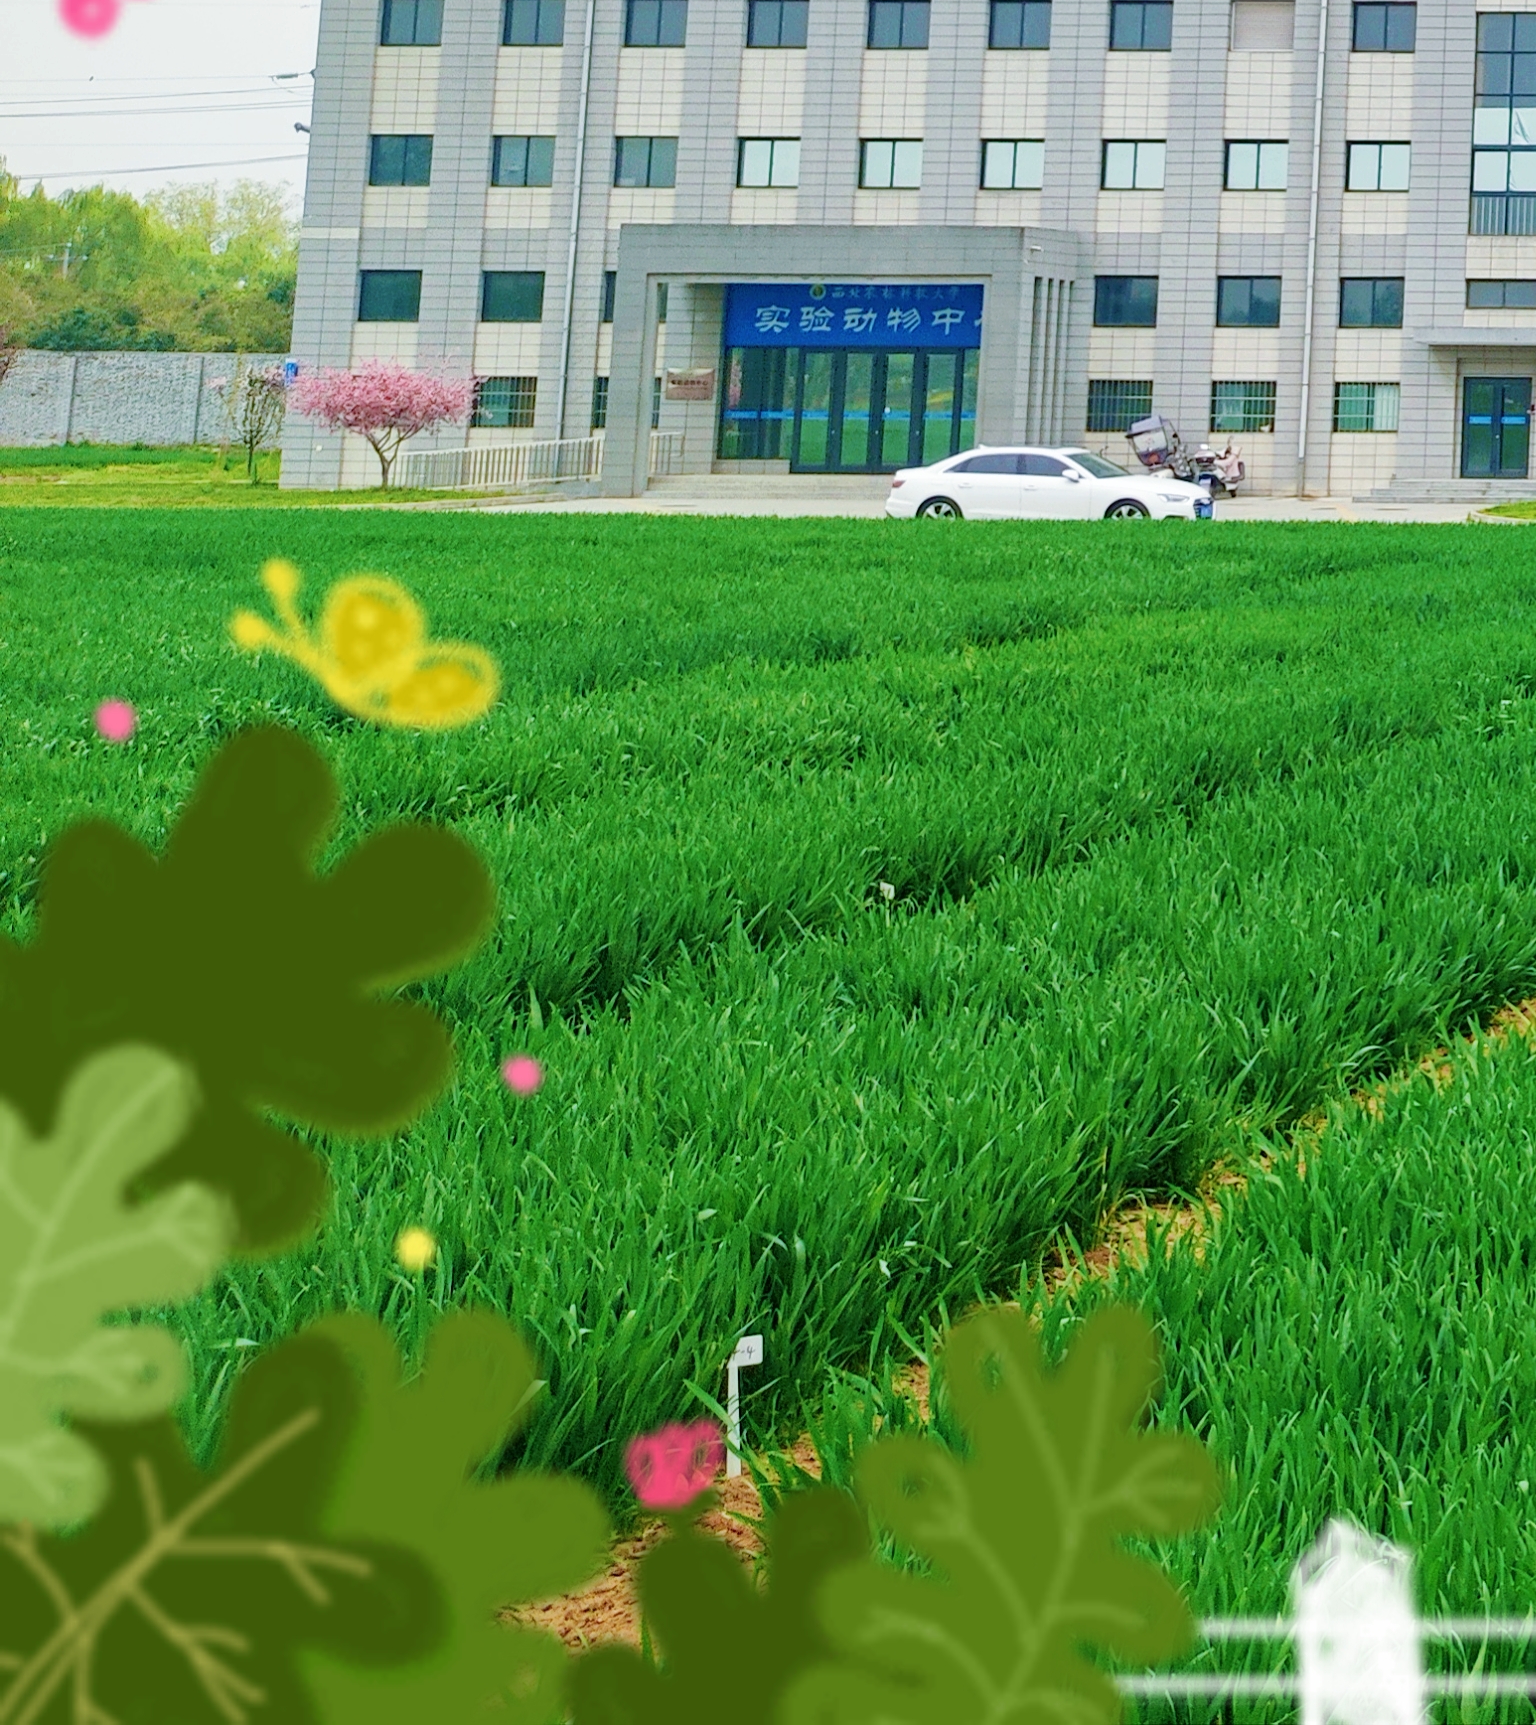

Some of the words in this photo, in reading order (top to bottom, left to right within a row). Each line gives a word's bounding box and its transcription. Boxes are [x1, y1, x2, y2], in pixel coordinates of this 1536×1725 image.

[754, 304, 983, 336] 实验动物中
